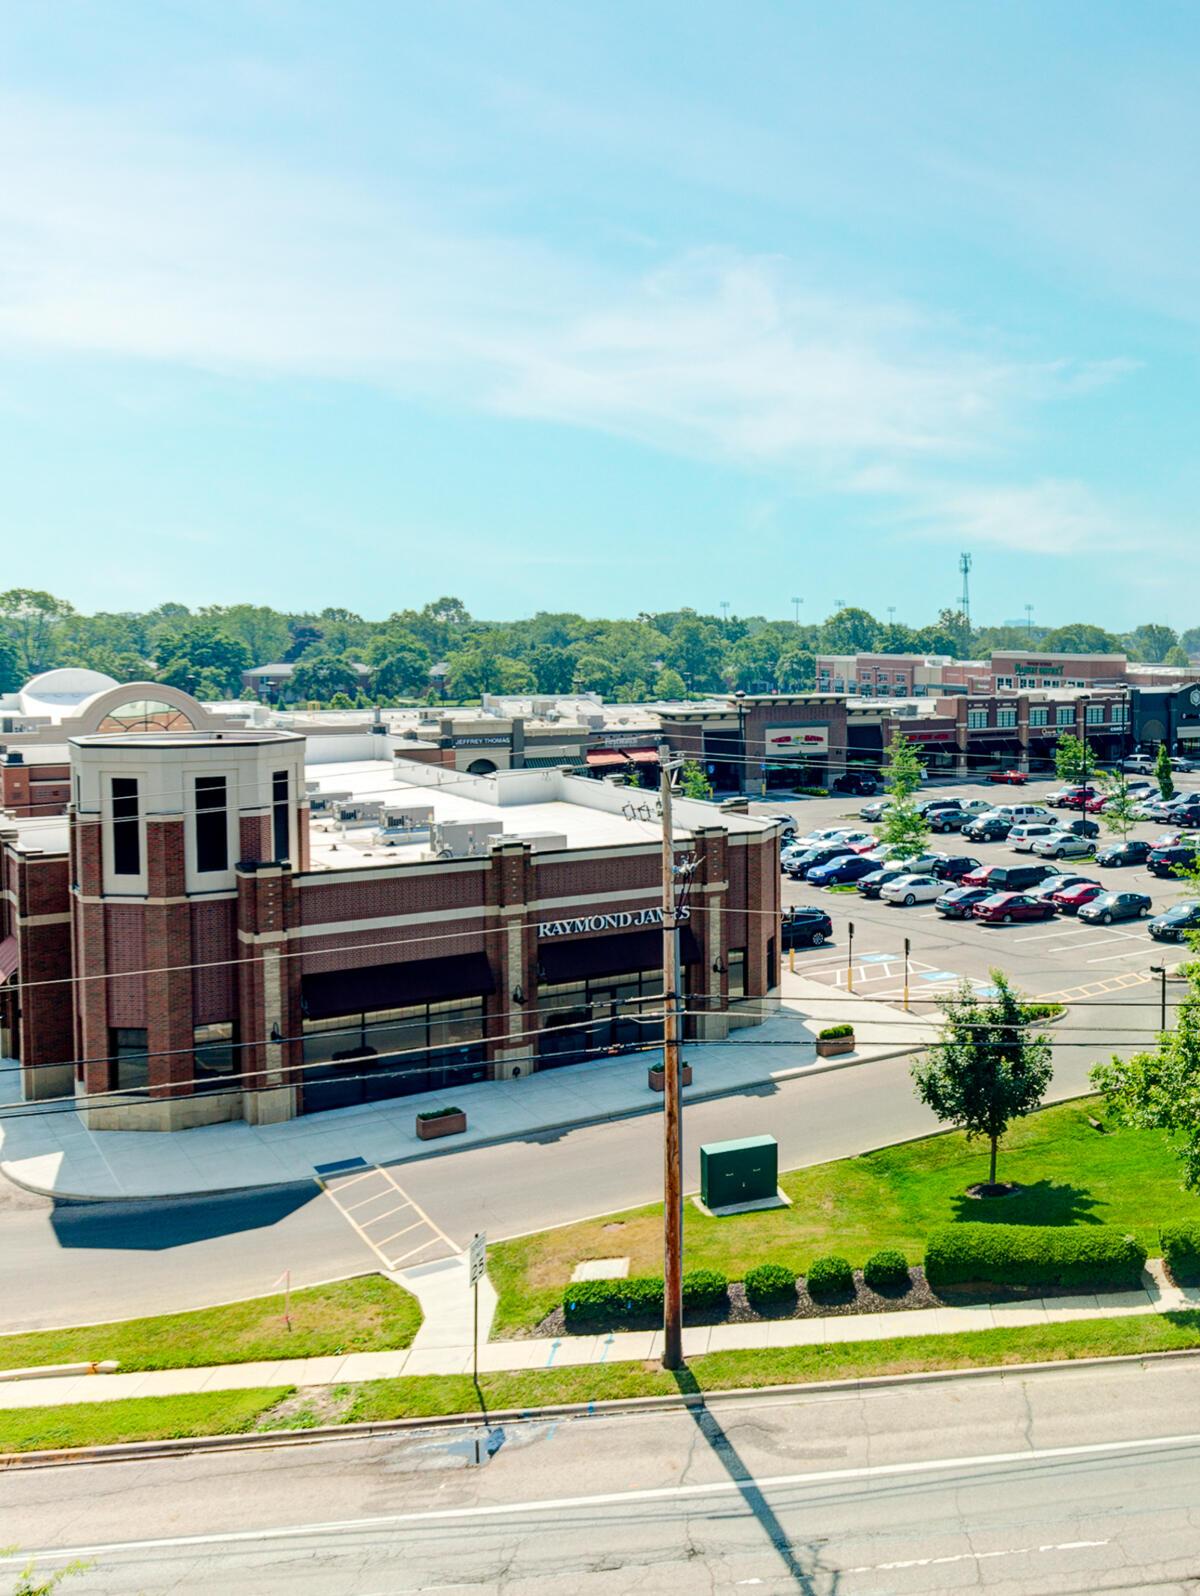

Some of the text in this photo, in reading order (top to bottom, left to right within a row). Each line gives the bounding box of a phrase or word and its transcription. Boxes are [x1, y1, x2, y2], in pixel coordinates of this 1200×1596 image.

[455, 736, 511, 746] JEFFREY THOMAS
[538, 913, 632, 938] RAYMOND
